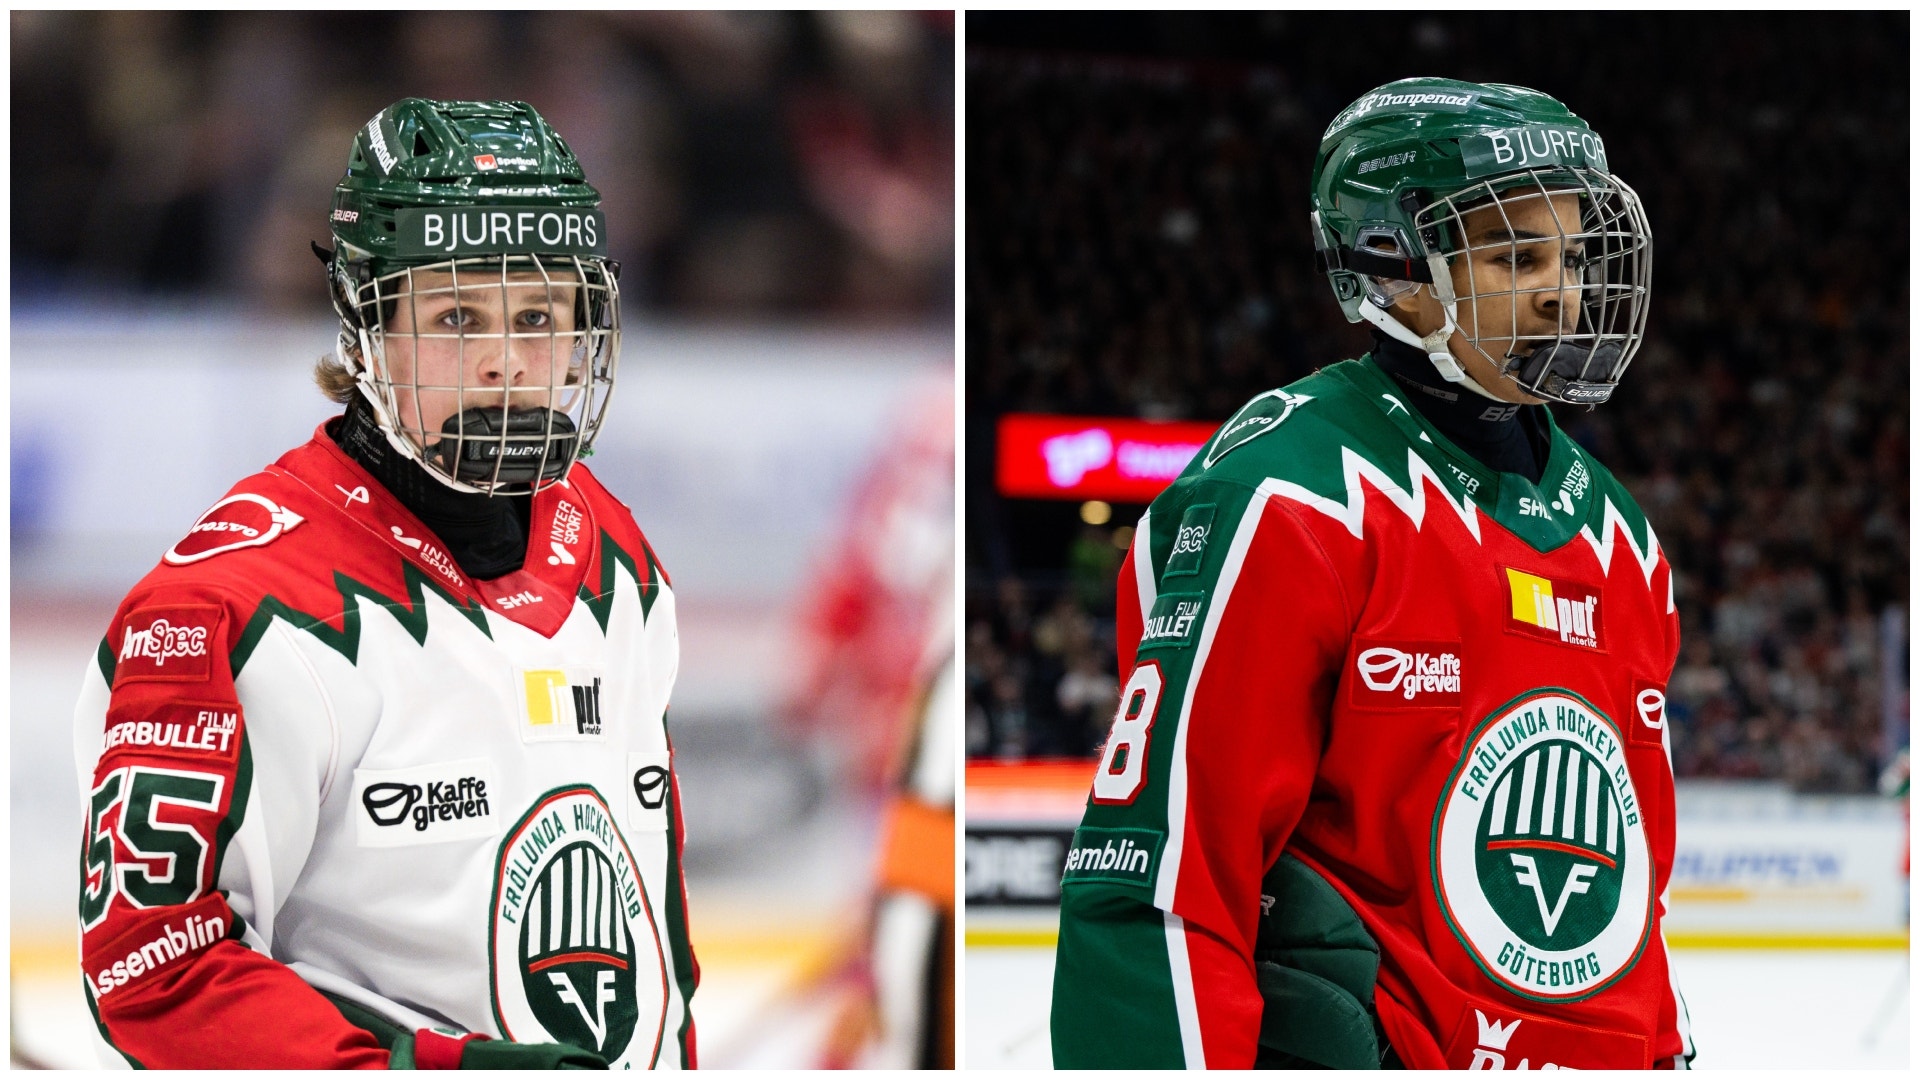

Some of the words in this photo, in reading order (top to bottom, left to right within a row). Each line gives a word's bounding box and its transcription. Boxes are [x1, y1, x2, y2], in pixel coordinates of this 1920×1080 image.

[1376, 93, 1473, 107] Tranpenad
[1358, 151, 1417, 174] BAUER
[424, 213, 597, 251] BJURFORS
[1223, 416, 1273, 440] VOLVO
[488, 446, 544, 456] BAUER
[1448, 464, 1480, 492] TER
[1561, 460, 1584, 492] INTER
[549, 500, 572, 541] INTER
[1519, 497, 1552, 521] SHL
[192, 521, 259, 537] VOLVO
[564, 506, 584, 545] SPORT
[496, 591, 543, 609] SHL
[1175, 602, 1201, 616] FILM
[1533, 583, 1597, 642] input
[1415, 653, 1460, 675] Kaffe
[1403, 674, 1460, 700] greven
[197, 711, 236, 730] FILM
[1092, 658, 1166, 805] 8
[1461, 706, 1550, 801] FRÖLUNDA
[1556, 706, 1617, 762] HOCKEY
[1614, 764, 1638, 827] CLUB
[427, 777, 487, 805] Kaffe
[413, 797, 490, 831] greven
[80, 765, 225, 933] 55
[502, 811, 567, 924] FRÖLUNDA
[573, 804, 616, 853] HOCKEY
[616, 851, 642, 920] CLUB
[1497, 941, 1601, 987] GÖTEBORG
